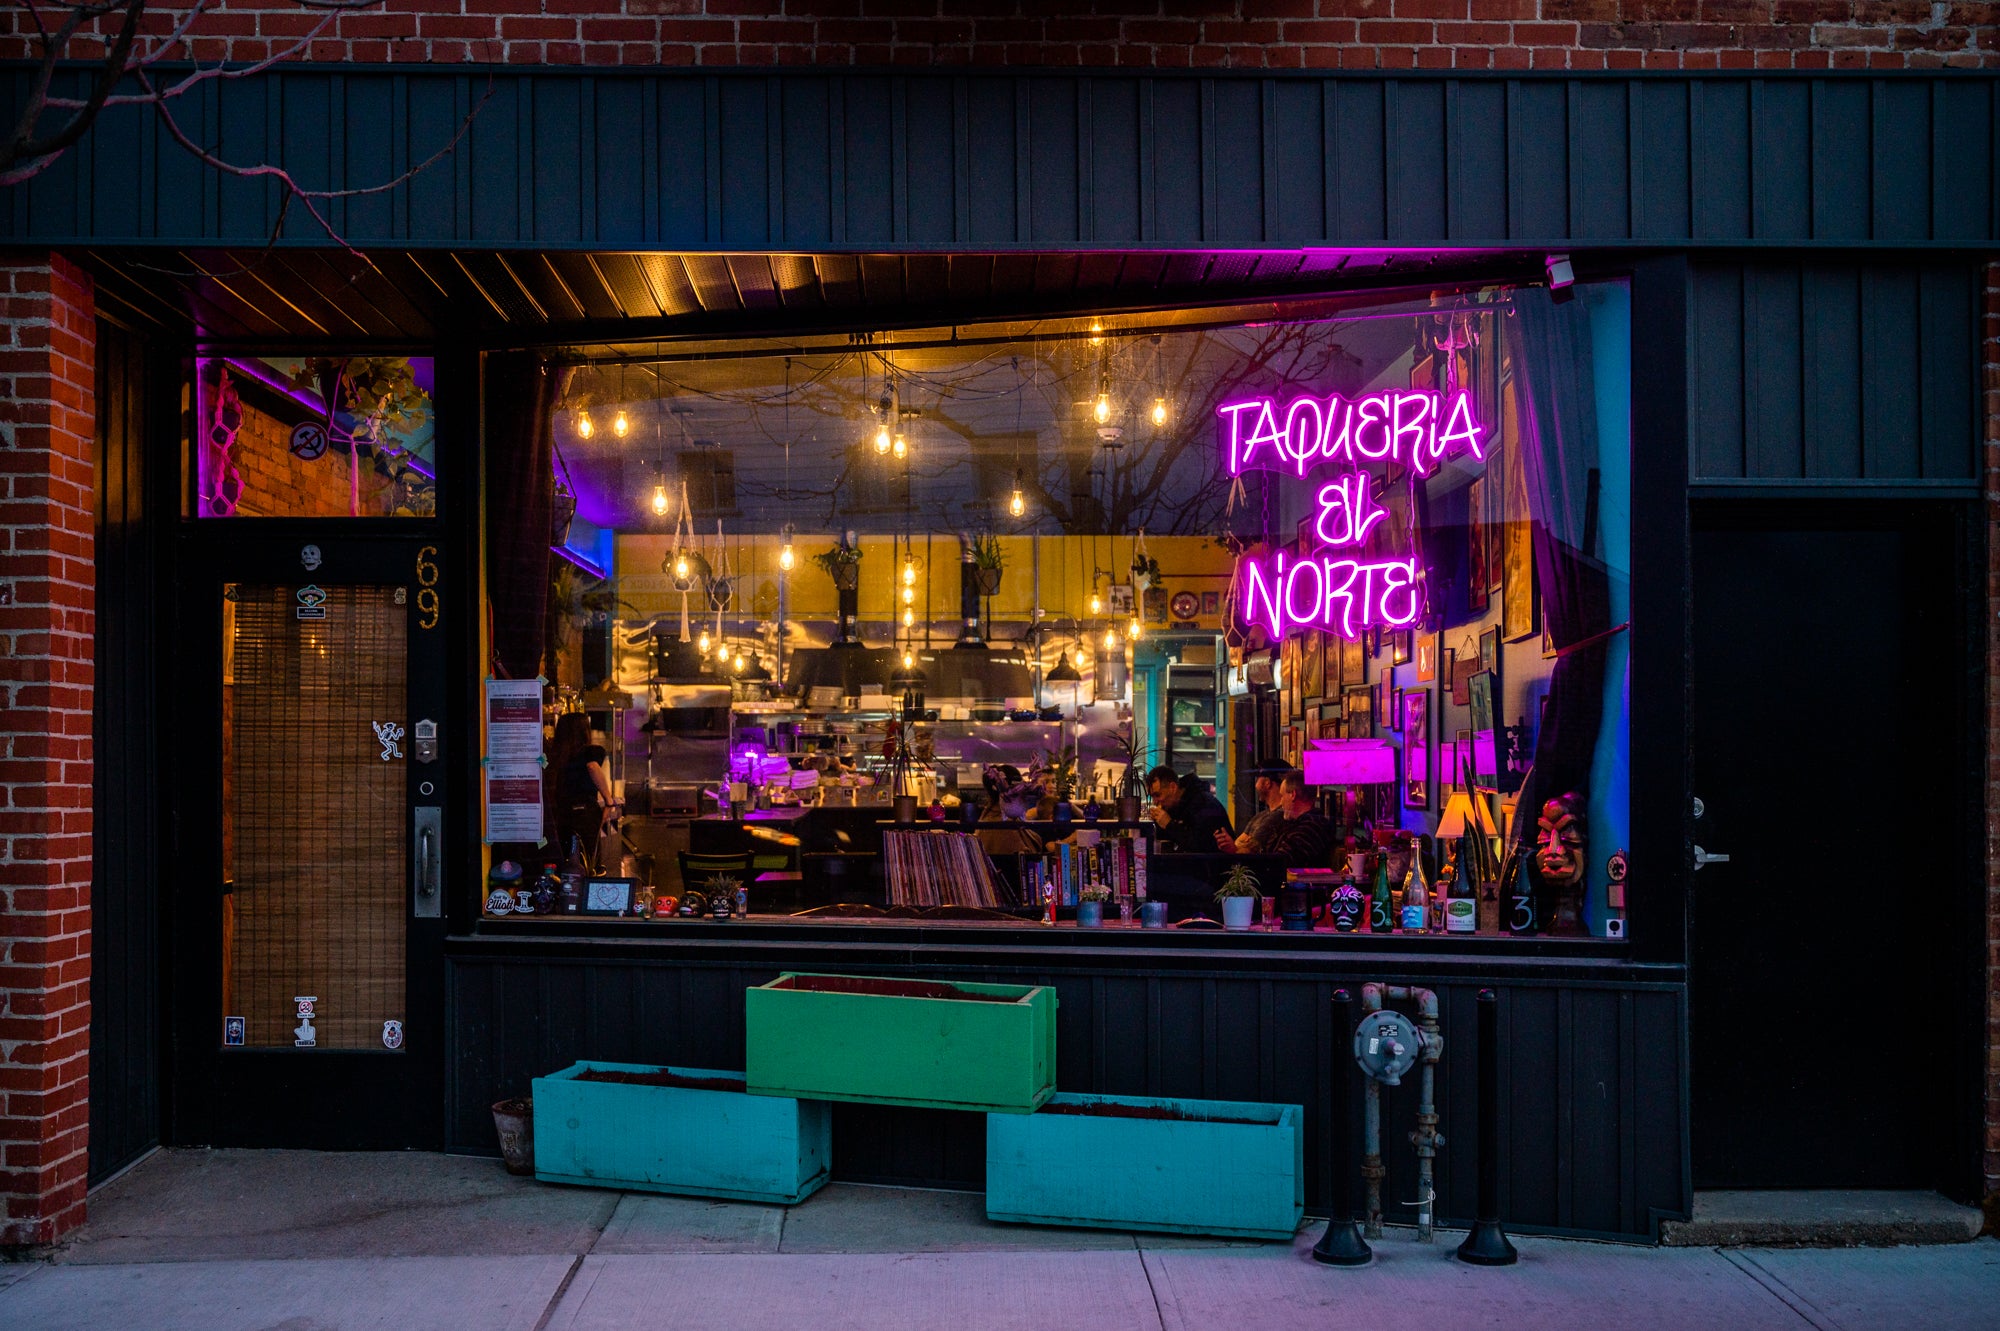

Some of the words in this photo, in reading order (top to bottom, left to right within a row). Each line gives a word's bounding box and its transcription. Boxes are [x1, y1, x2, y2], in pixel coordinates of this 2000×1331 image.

[1247, 552, 1417, 638] NORTE
[486, 898, 514, 910] Elliott
[1371, 901, 1386, 927] 3
[1510, 895, 1533, 931] 3
